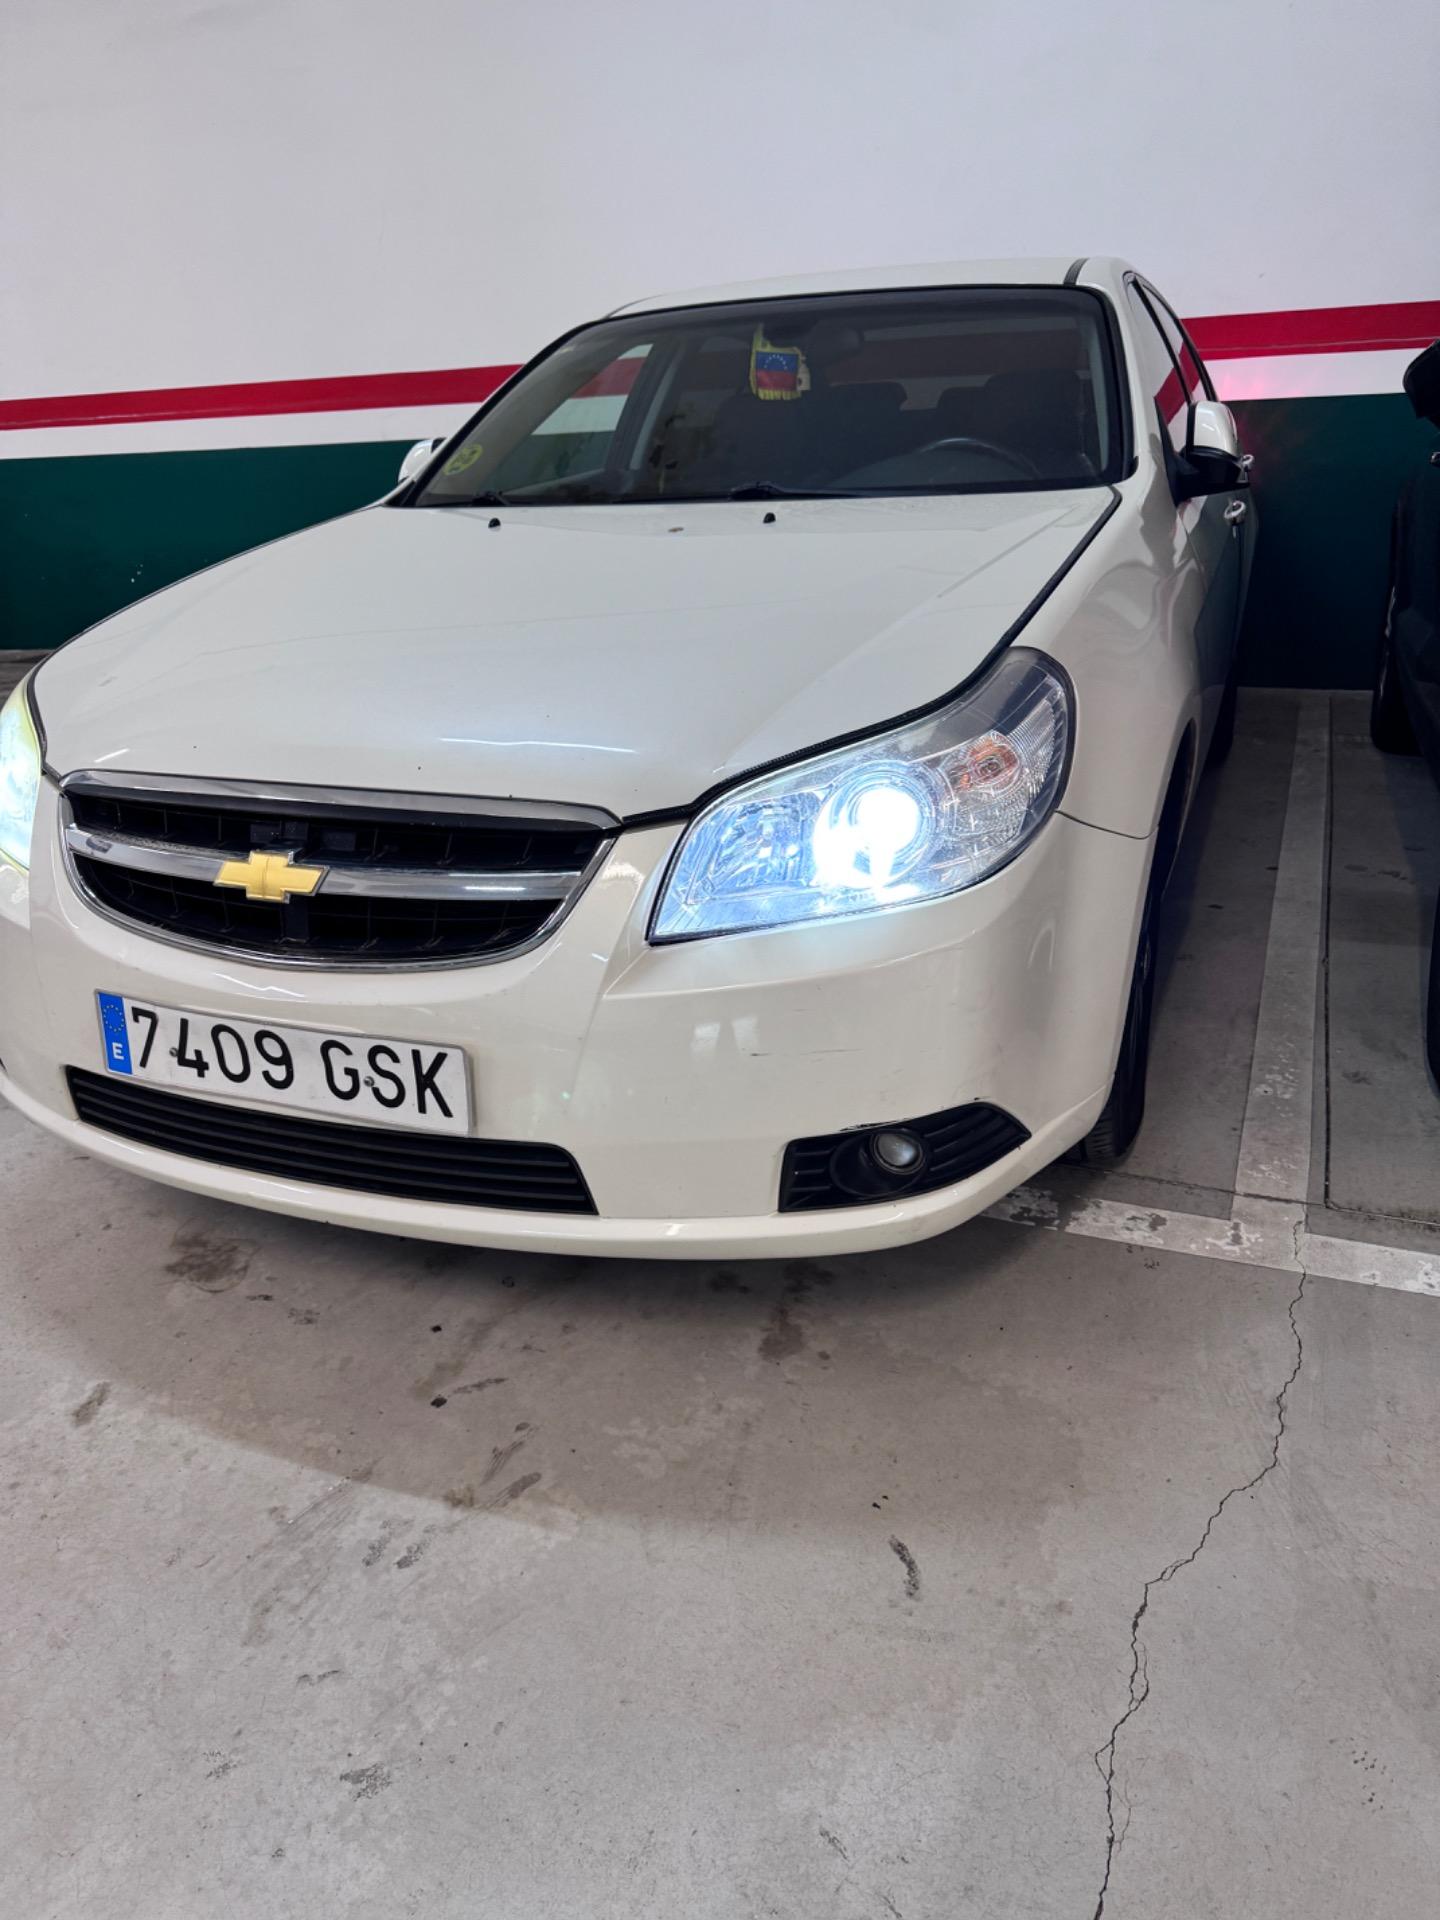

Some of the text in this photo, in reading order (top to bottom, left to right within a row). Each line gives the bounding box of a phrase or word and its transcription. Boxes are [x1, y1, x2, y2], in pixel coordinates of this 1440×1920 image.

[112, 1042, 124, 1060] E
[131, 1007, 454, 1118] 7409 GSK
